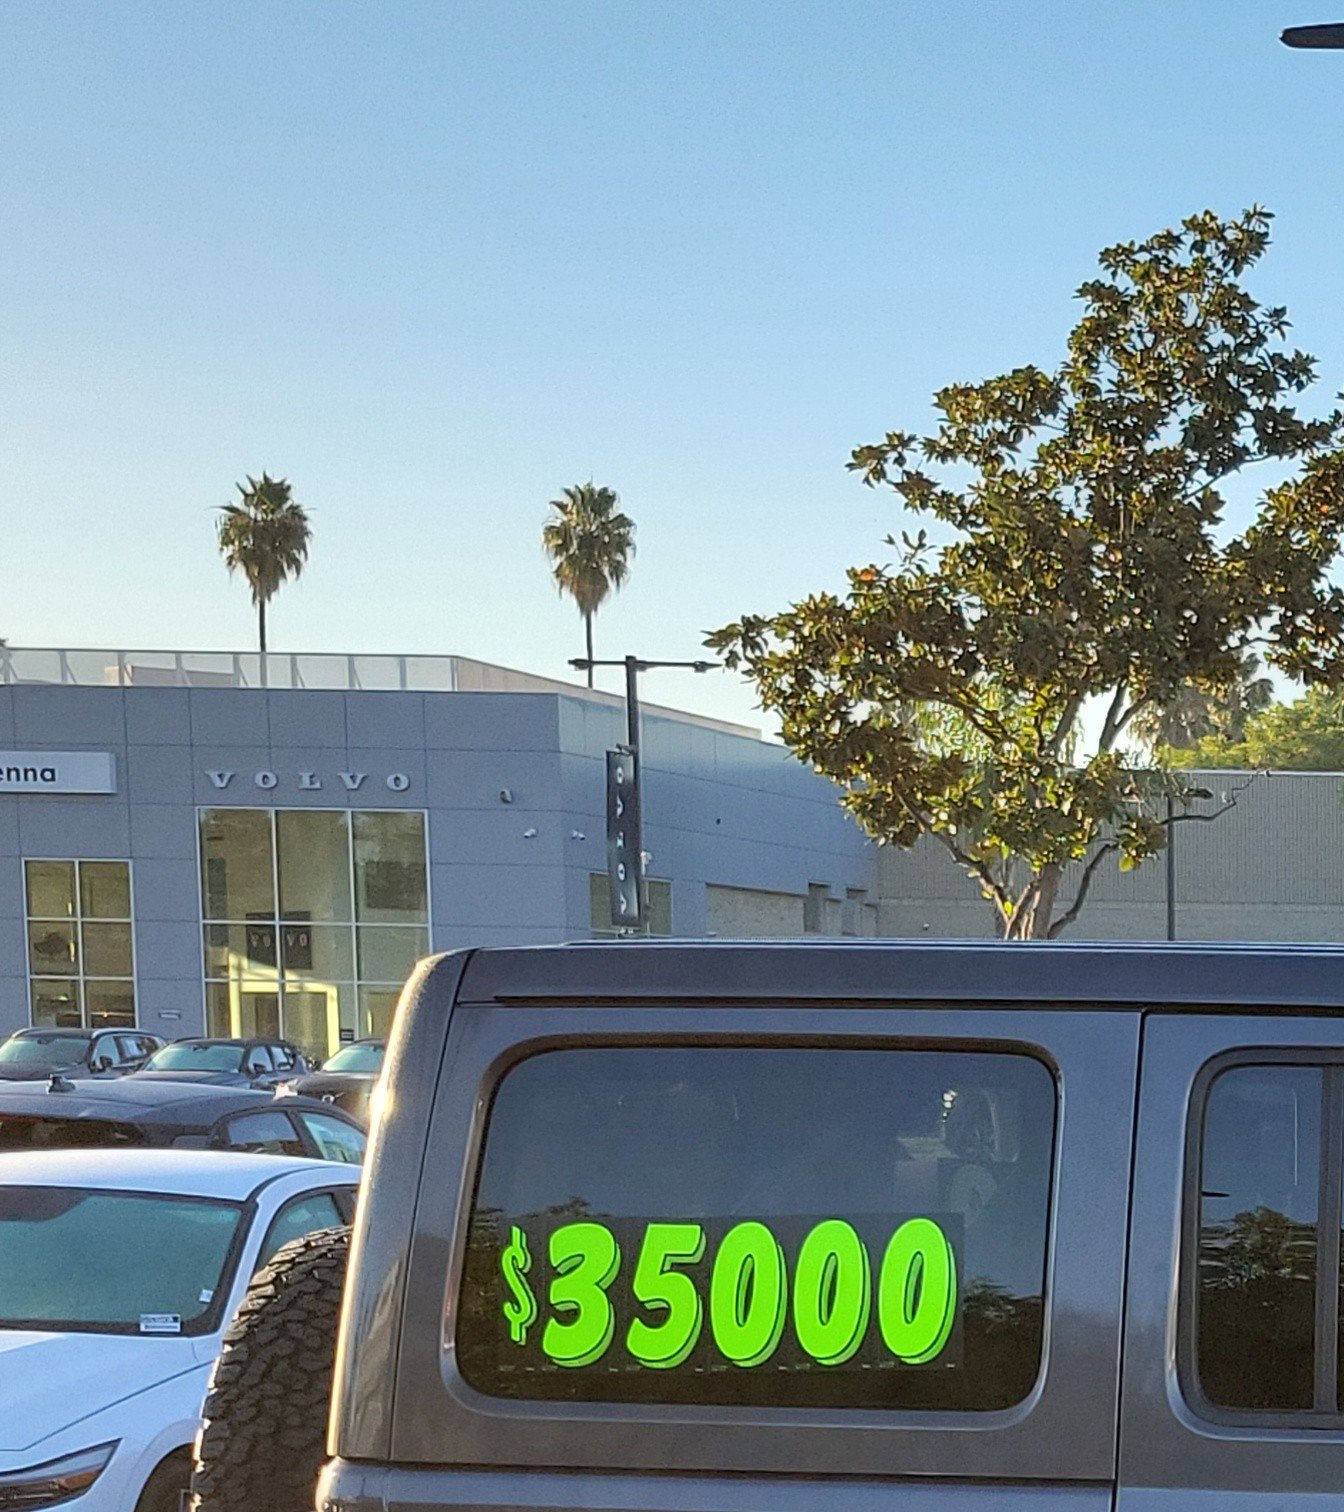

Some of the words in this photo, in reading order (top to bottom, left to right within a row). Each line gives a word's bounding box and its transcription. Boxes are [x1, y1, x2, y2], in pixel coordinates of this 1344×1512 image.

[205, 770, 411, 792] VOLVO
[616, 766, 627, 915] VOLVO
[502, 1217, 957, 1369] $35000
